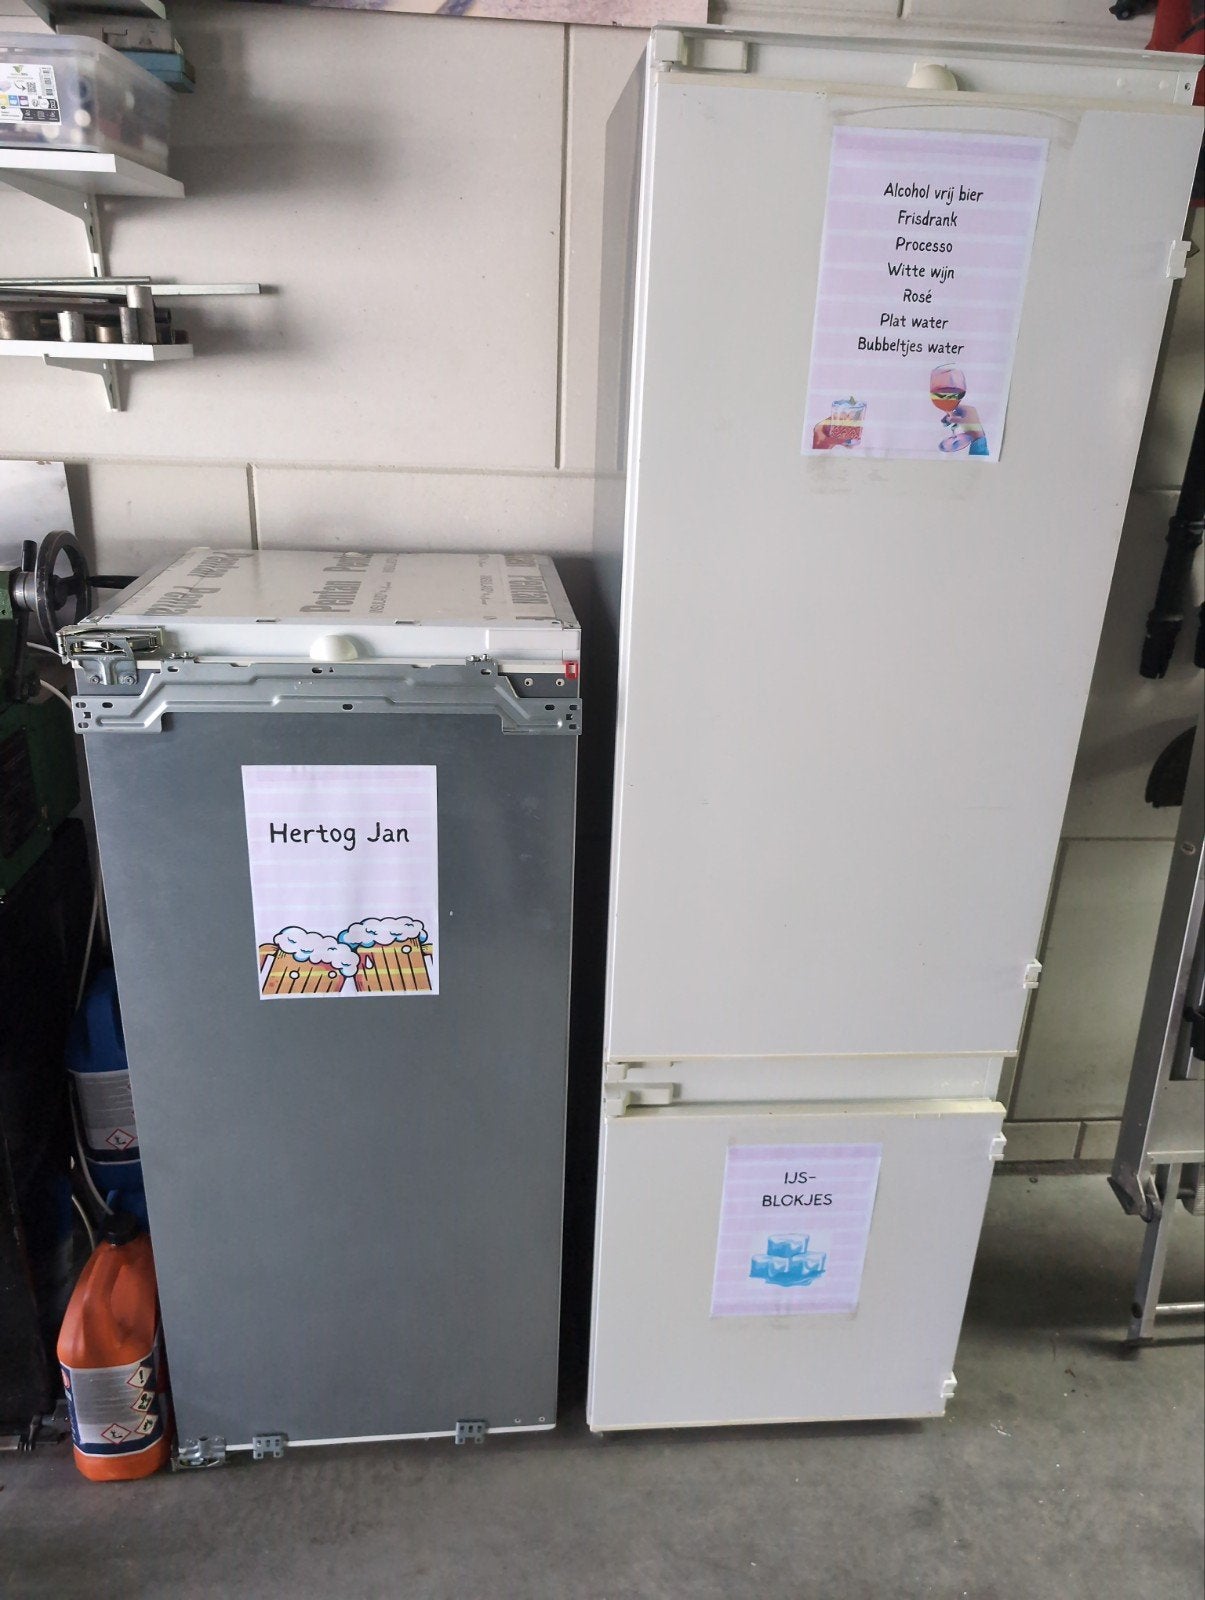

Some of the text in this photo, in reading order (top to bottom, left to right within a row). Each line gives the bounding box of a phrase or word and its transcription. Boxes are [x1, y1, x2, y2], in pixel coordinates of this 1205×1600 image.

[884, 182, 984, 206] Alcohol vrij bier
[898, 210, 958, 228] Frisdrank
[895, 236, 953, 253] Processo
[887, 262, 955, 284] Witte wijn
[903, 288, 933, 304] Rosé
[880, 313, 949, 330] Plat water
[857, 336, 965, 358] Bubbeltjes water
[299, 580, 362, 613] Pentan
[269, 821, 410, 851] Hertog Jan
[784, 1171, 817, 1185] IJS-
[761, 1193, 833, 1207] BLOKJES
